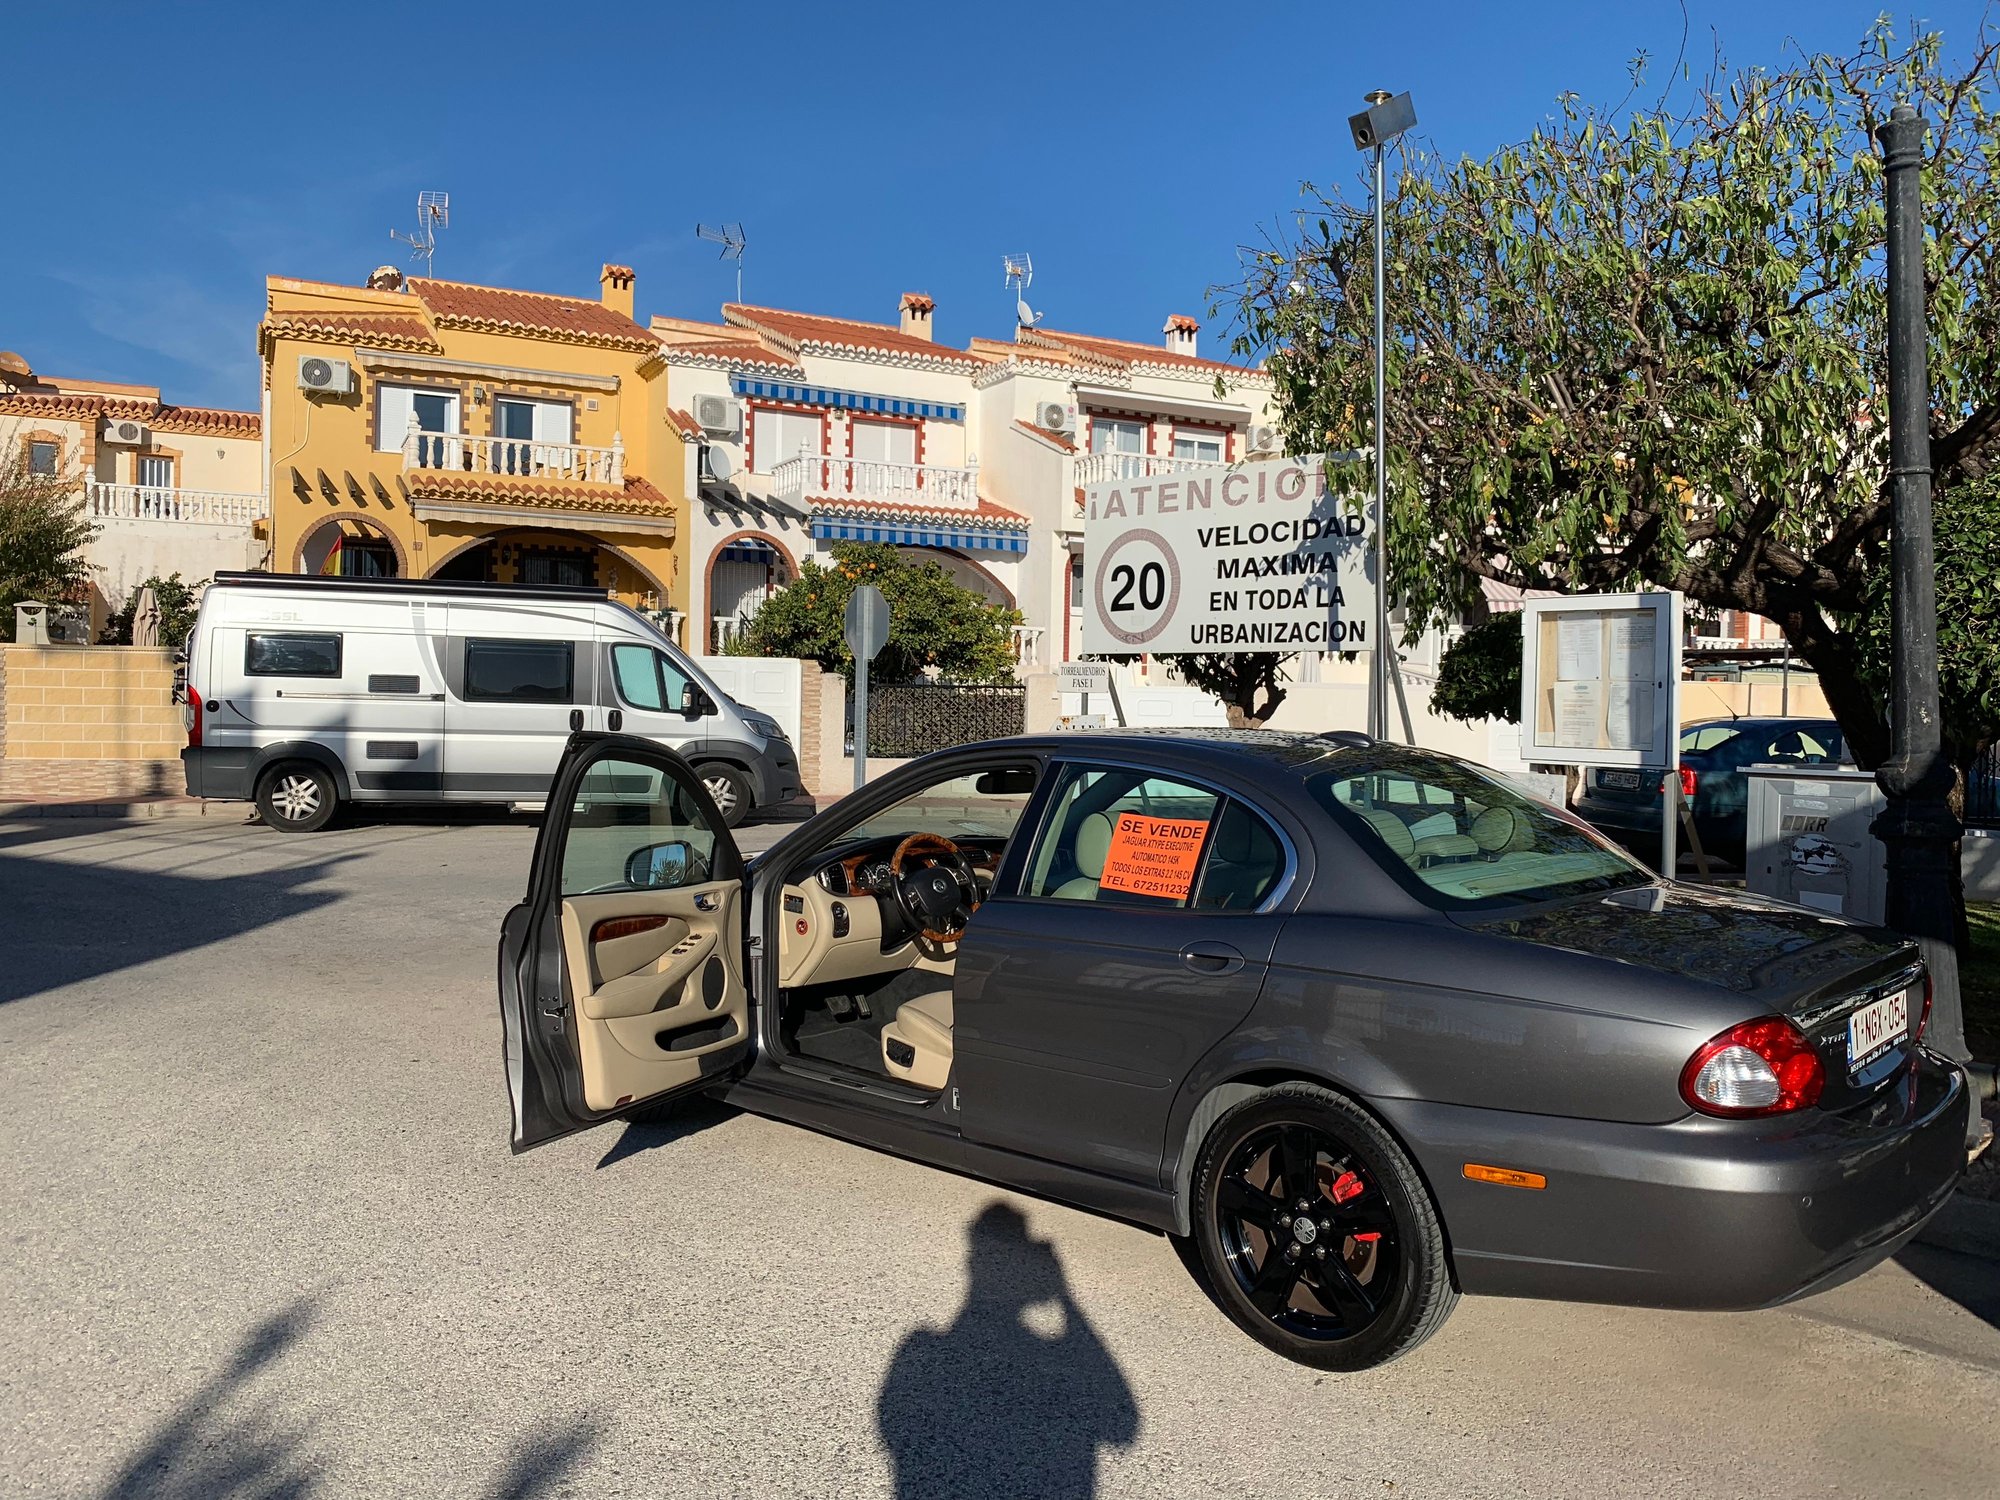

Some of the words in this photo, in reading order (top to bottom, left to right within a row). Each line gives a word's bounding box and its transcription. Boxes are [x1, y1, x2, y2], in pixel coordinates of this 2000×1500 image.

[1197, 515, 1366, 548] VELOCIDAD
[1216, 551, 1338, 579] MAXIMA
[1110, 561, 1166, 613] 20
[1209, 591, 1238, 611] EN
[1245, 588, 1307, 610] TODA
[1316, 586, 1346, 608] LA
[1190, 620, 1367, 644] URBANIZACION
[1072, 679, 1089, 688] FASE
[1120, 819, 1145, 834] SE
[1149, 823, 1204, 839] VENDE
[1122, 835, 1147, 847] JAGUAR
[1165, 841, 1195, 852] EXECUTIVE
[1131, 851, 1167, 864] AUTOMATICO
[1112, 861, 1131, 873] TODOS
[1131, 864, 1144, 875] LOS
[1144, 867, 1165, 879] EXTRAS
[1106, 875, 1129, 887] TEL.
[1133, 880, 1190, 895] 672511232
